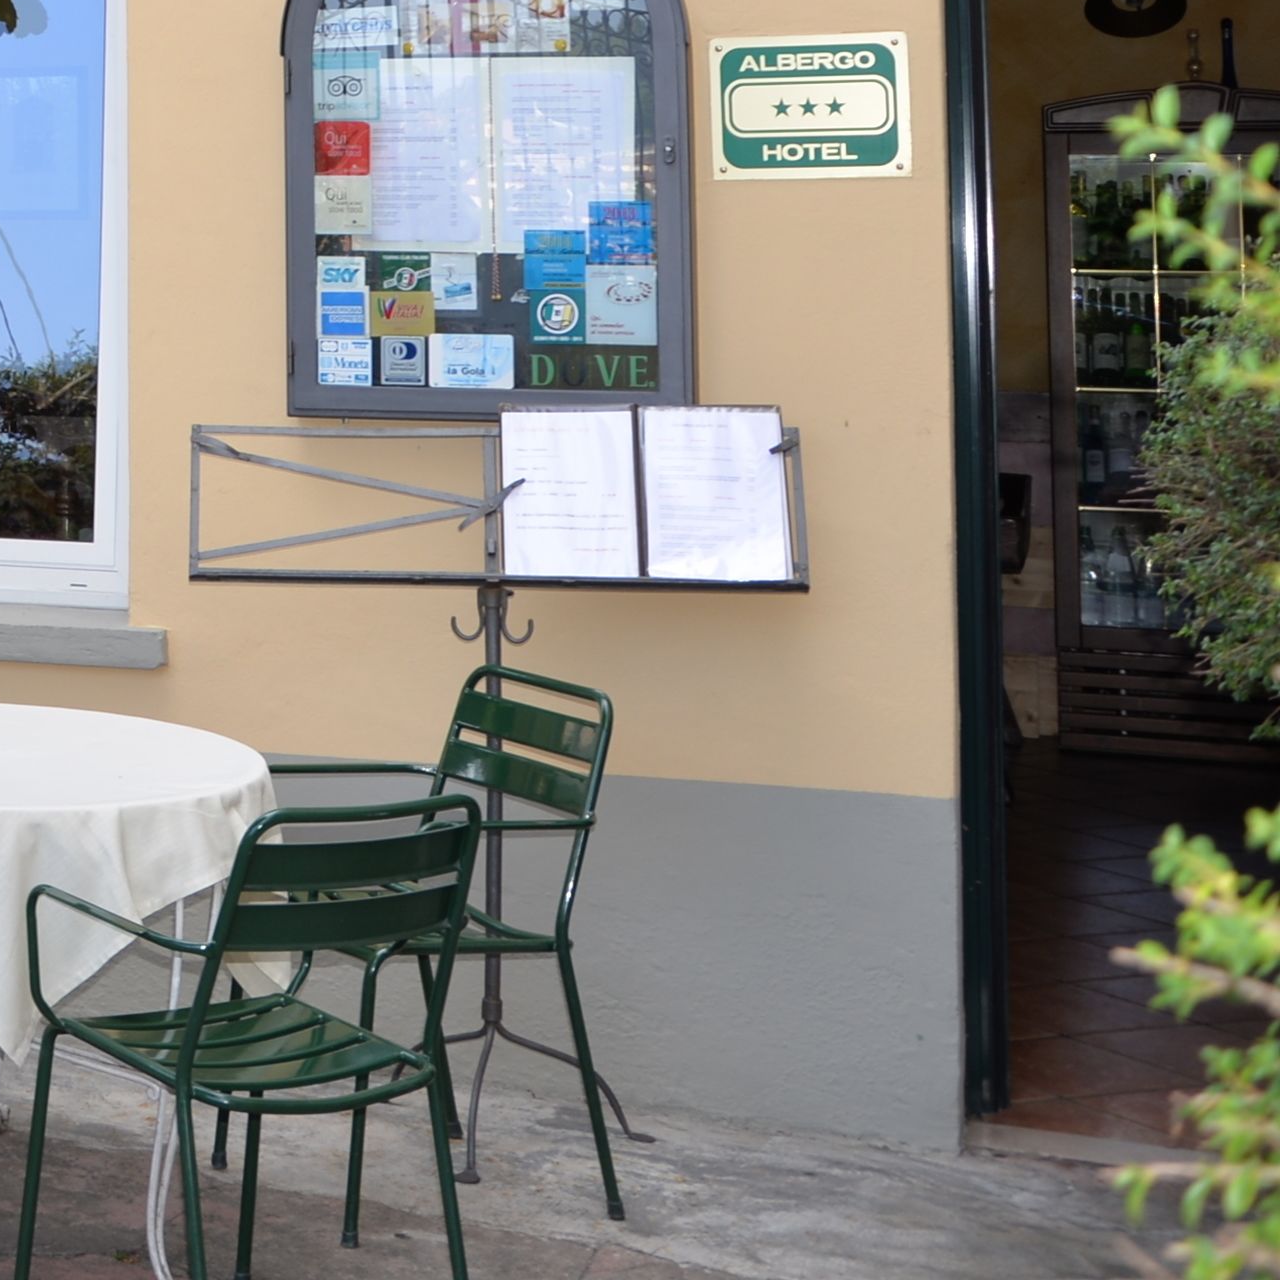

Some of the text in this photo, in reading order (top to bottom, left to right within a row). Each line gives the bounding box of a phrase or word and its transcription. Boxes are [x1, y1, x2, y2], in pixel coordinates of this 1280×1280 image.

[739, 51, 876, 72] ALBERGO
[762, 143, 858, 162] HOTEL
[322, 267, 361, 283] SKY
[334, 356, 369, 369] Moneta
